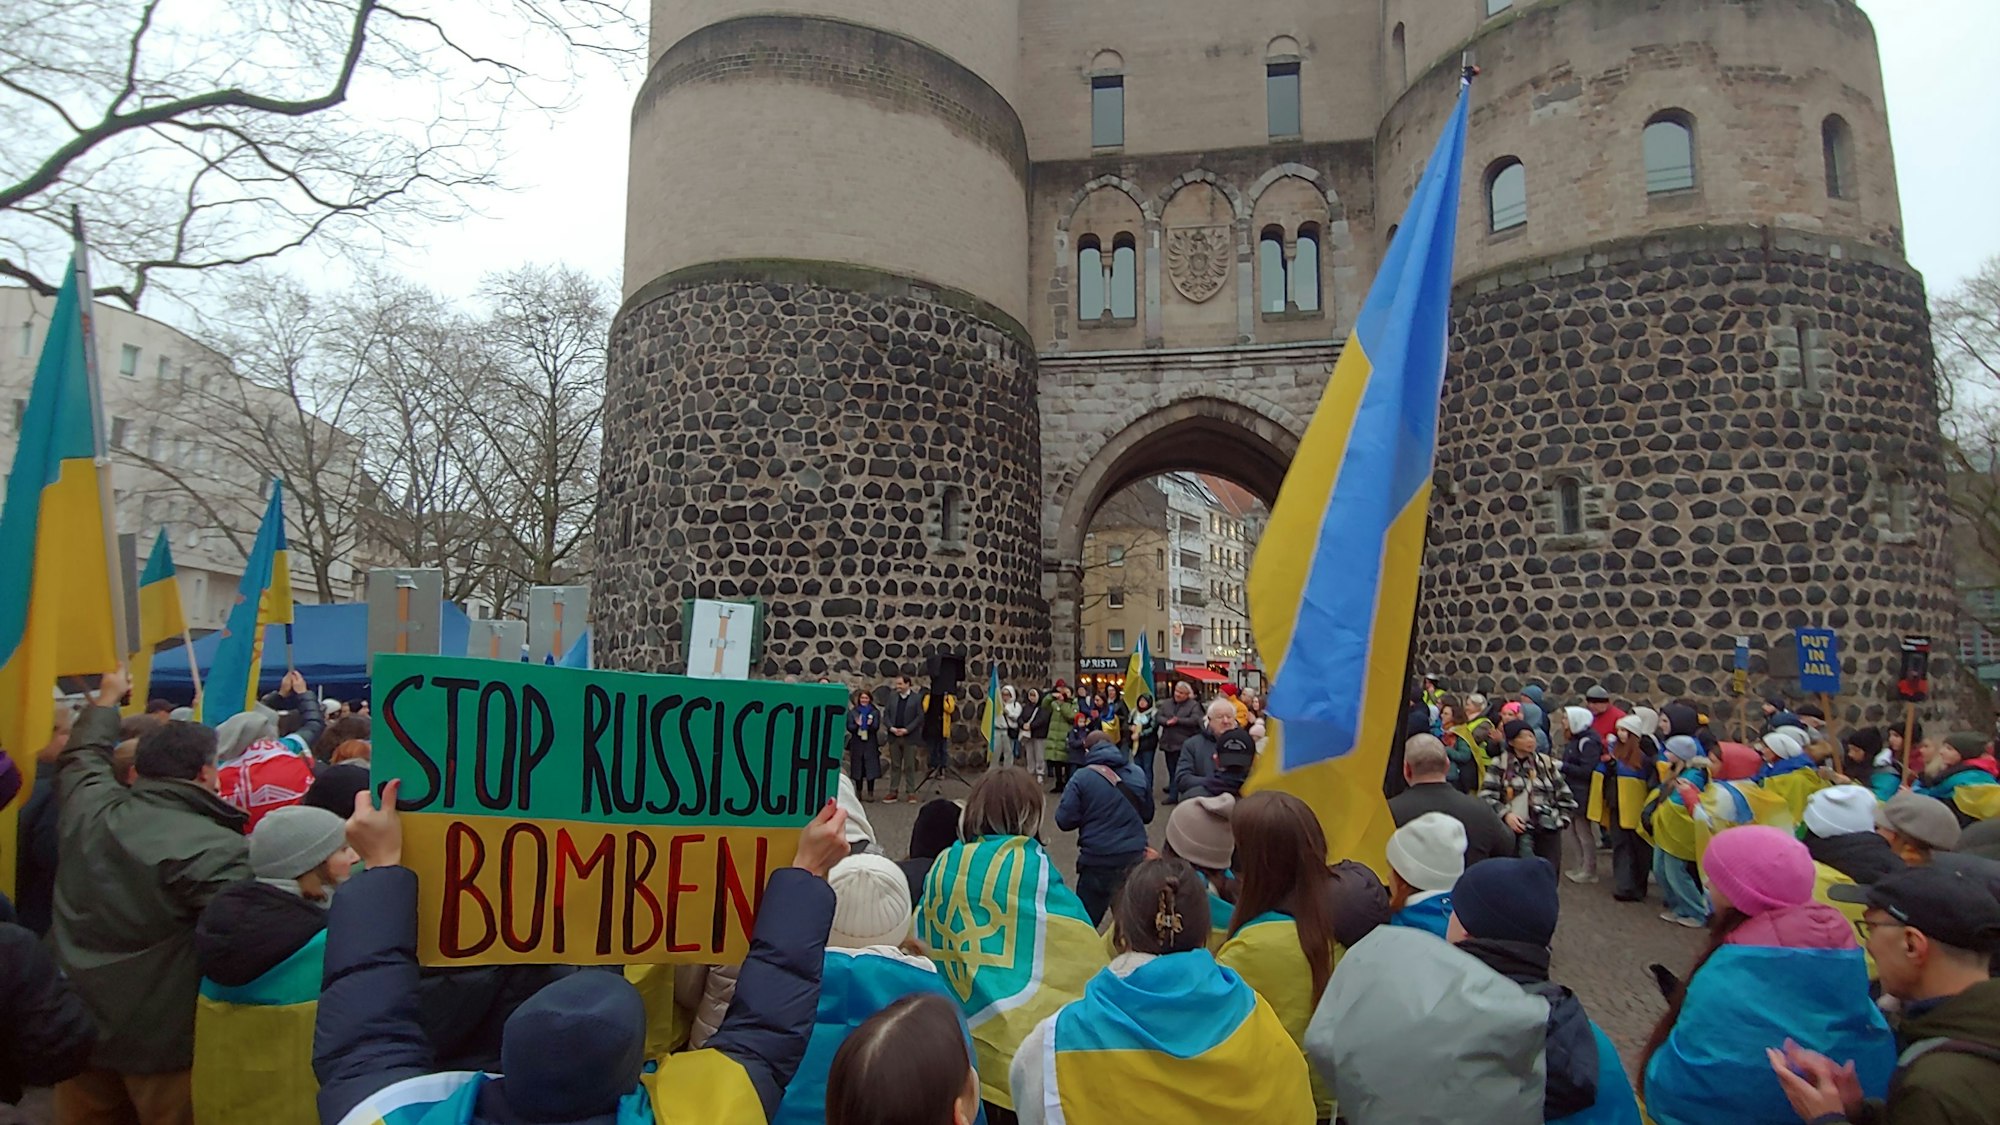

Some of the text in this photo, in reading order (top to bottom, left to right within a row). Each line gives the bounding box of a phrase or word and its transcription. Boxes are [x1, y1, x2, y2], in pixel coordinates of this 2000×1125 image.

[1801, 635, 1830, 649] PUT
[1808, 649, 1826, 662] IN
[1803, 662, 1835, 676] JAIL
[378, 674, 846, 817] STOP RUSSISCHE
[438, 821, 768, 959] BOMBEN
